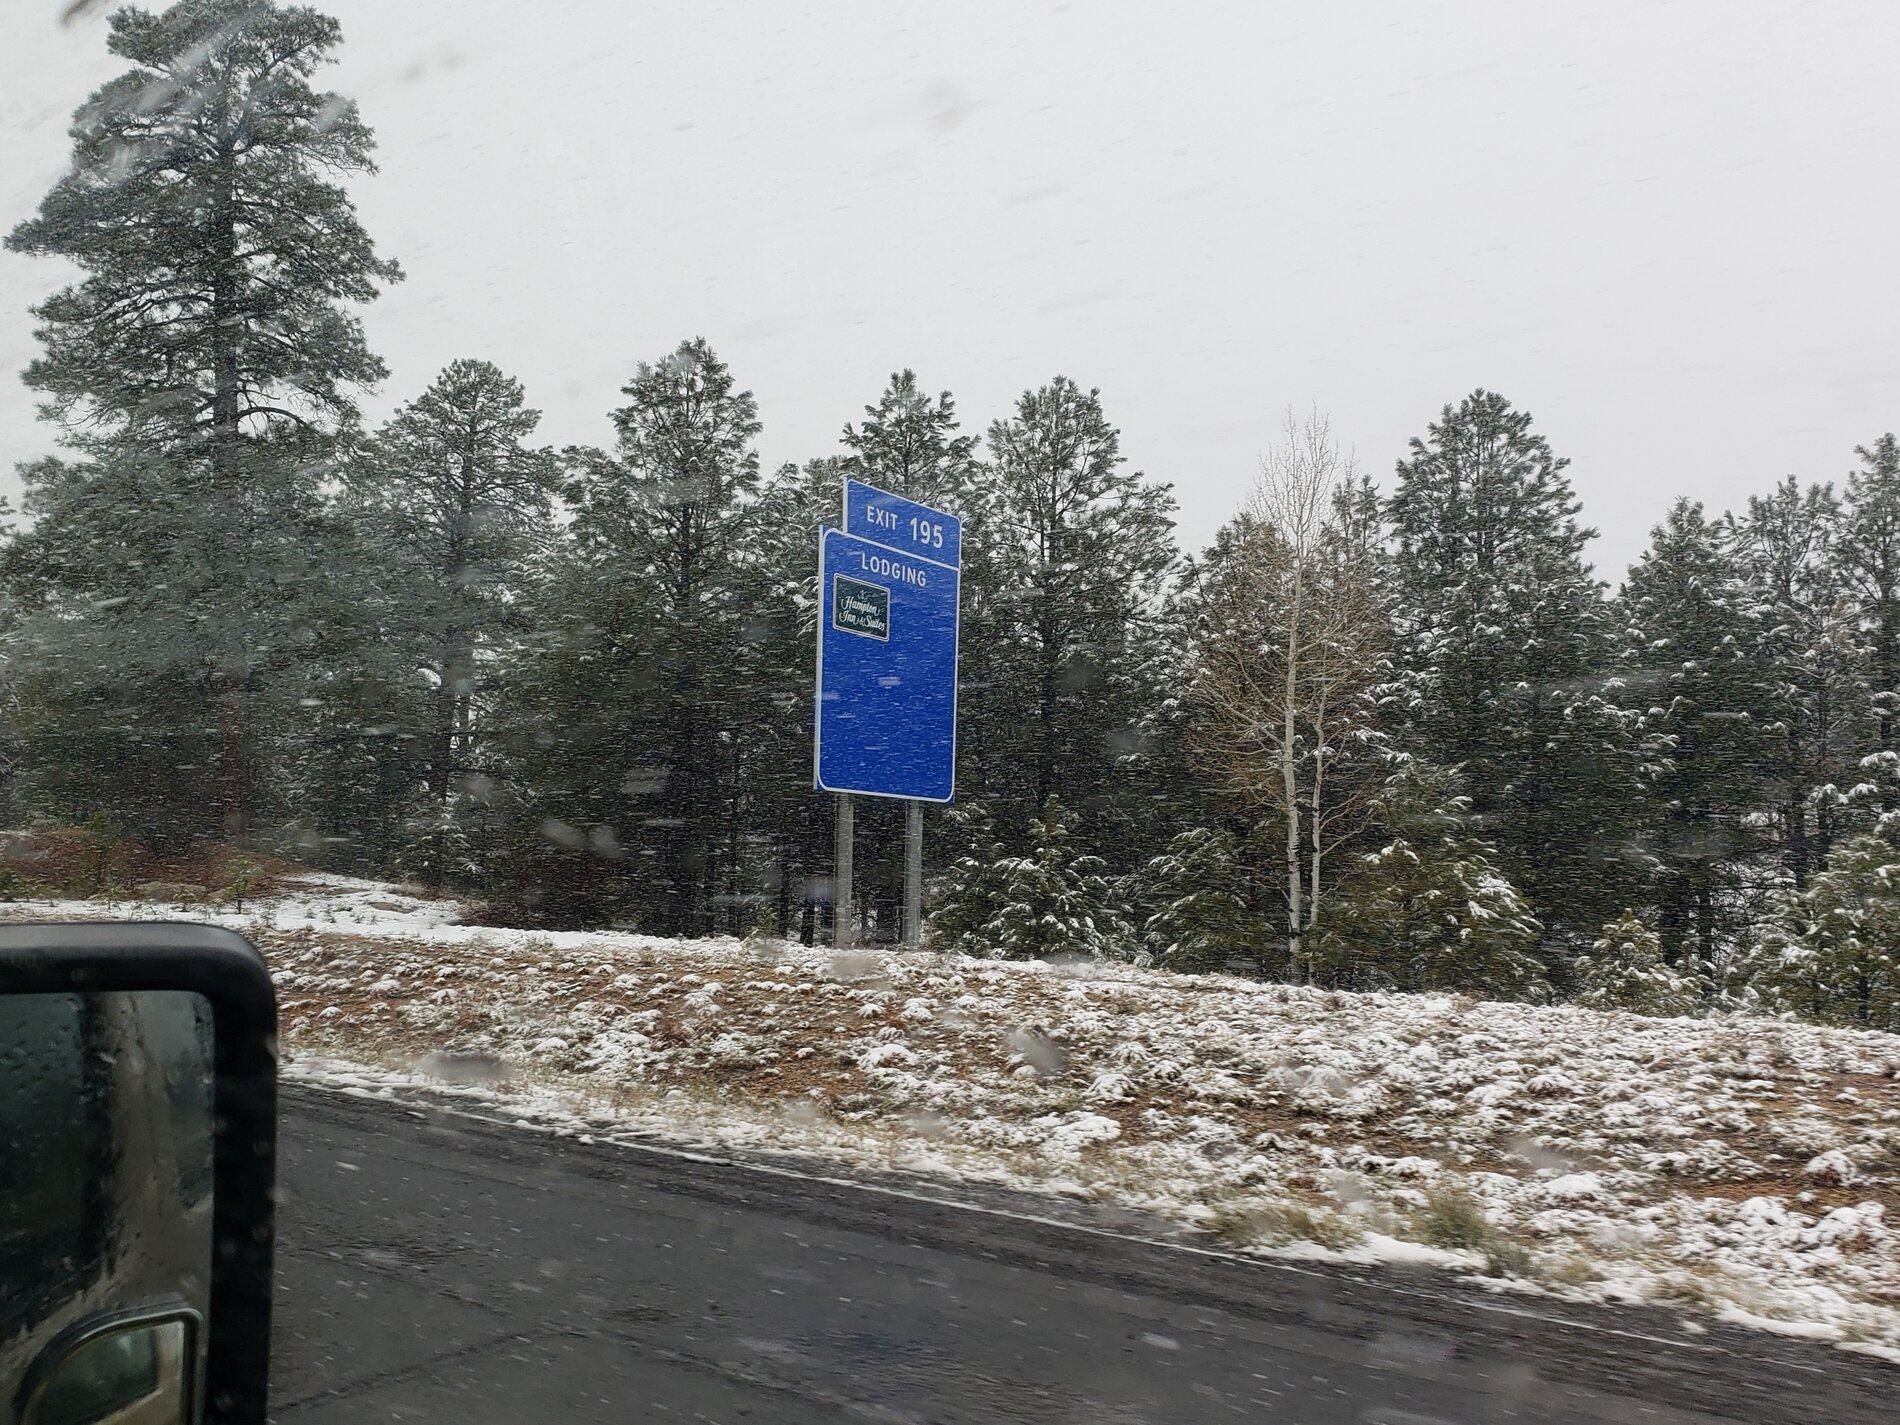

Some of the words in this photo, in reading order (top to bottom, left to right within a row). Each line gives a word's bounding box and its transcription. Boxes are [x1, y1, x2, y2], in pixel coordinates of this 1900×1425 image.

[867, 505, 898, 530] EXIT
[910, 517, 943, 549] 195
[861, 553, 926, 587] LODGING
[841, 596, 880, 616] Hampton
[839, 610, 859, 625] Inn
[865, 615, 885, 631] Suites
